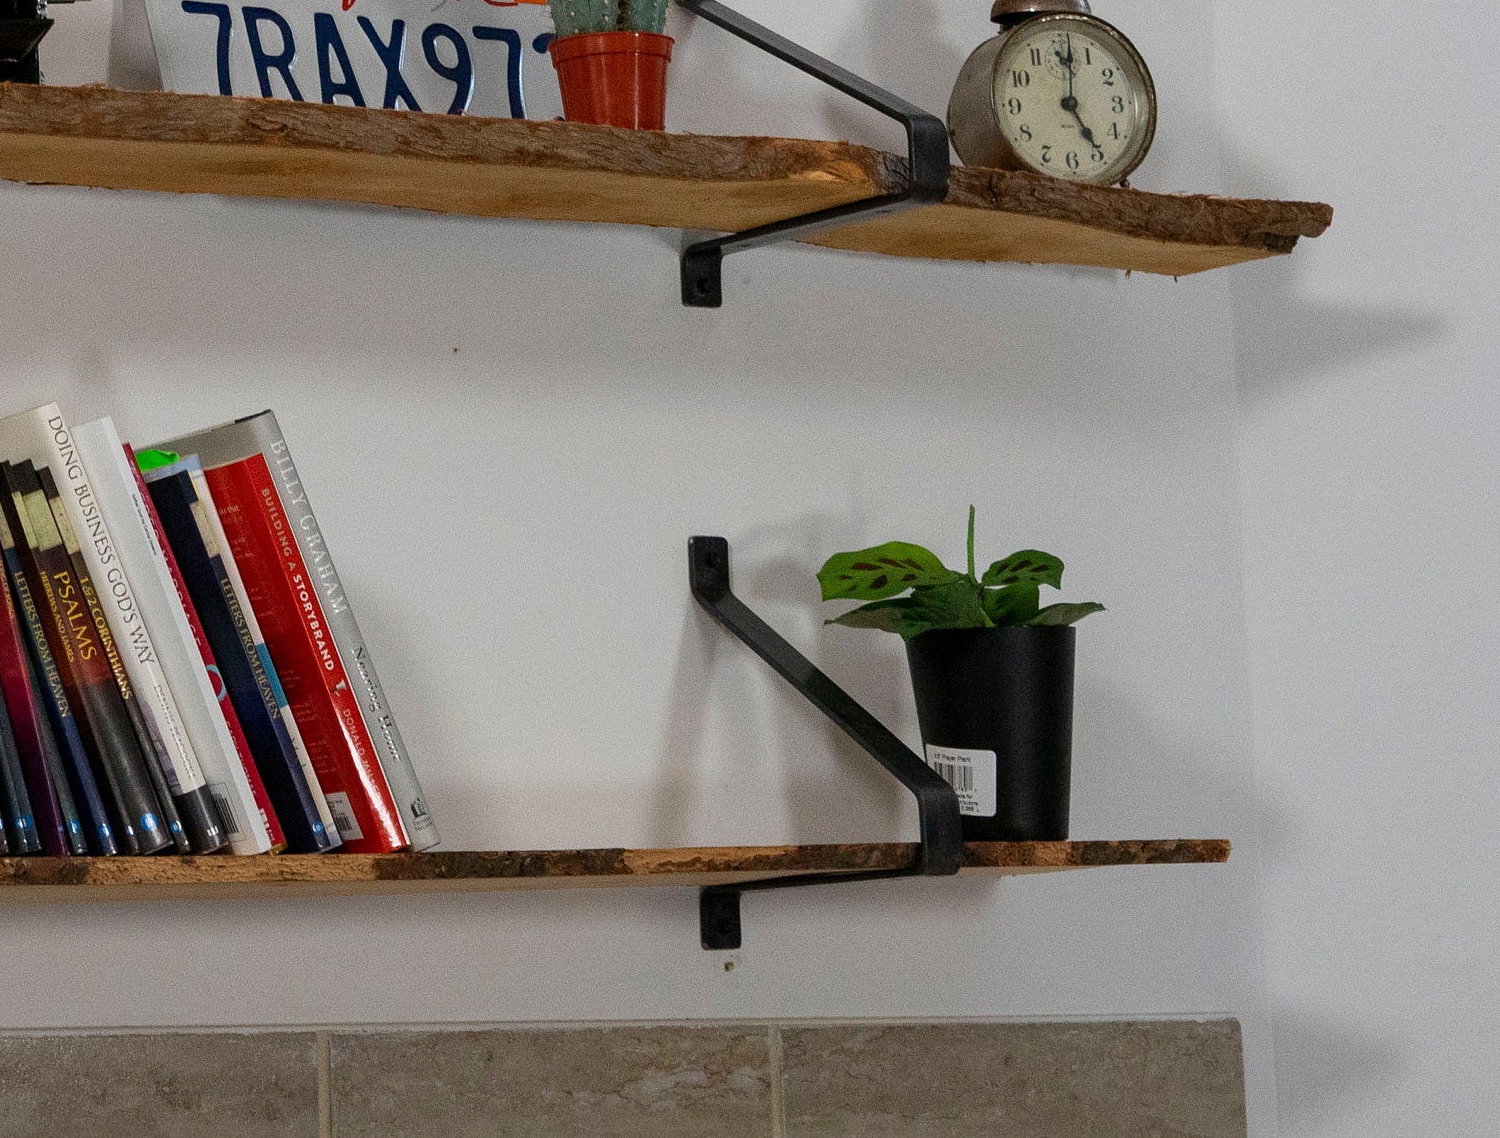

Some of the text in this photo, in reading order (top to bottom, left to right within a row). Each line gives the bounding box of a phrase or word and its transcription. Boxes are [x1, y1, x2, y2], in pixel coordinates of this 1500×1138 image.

[181, 0, 560, 121] 7RAX97
[1012, 69, 1030, 88] 10
[1030, 48, 1042, 66] 11
[1084, 47, 1091, 65] 1
[1102, 67, 1114, 87] 2
[1008, 98, 1022, 116] 9
[1111, 96, 1124, 114] 3
[1019, 124, 1033, 142] 8
[1041, 145, 1052, 163] 7
[1107, 123, 1121, 140] 4
[1065, 151, 1080, 170] 6
[48, 416, 155, 665] DOING BUSINESS GOD'S WAY
[271, 439, 349, 615] BILLY GRAHAM
[261, 488, 293, 557] BUILDING
[288, 561, 297, 571] A
[293, 574, 334, 671] STORYBRAND
[54, 571, 98, 661] PSALMS
[55, 613, 66, 634] AND
[62, 634, 74, 663] JAMES
[14, 571, 69, 718] LETTERS FROM HEAVEN
[87, 596, 97, 607] 2
[92, 607, 133, 700] CORINTHIANS
[220, 578, 280, 719] LETTERS FROM HEAVEN
[351, 646, 401, 764] Nearing Home
[343, 709, 365, 755] DONALD
